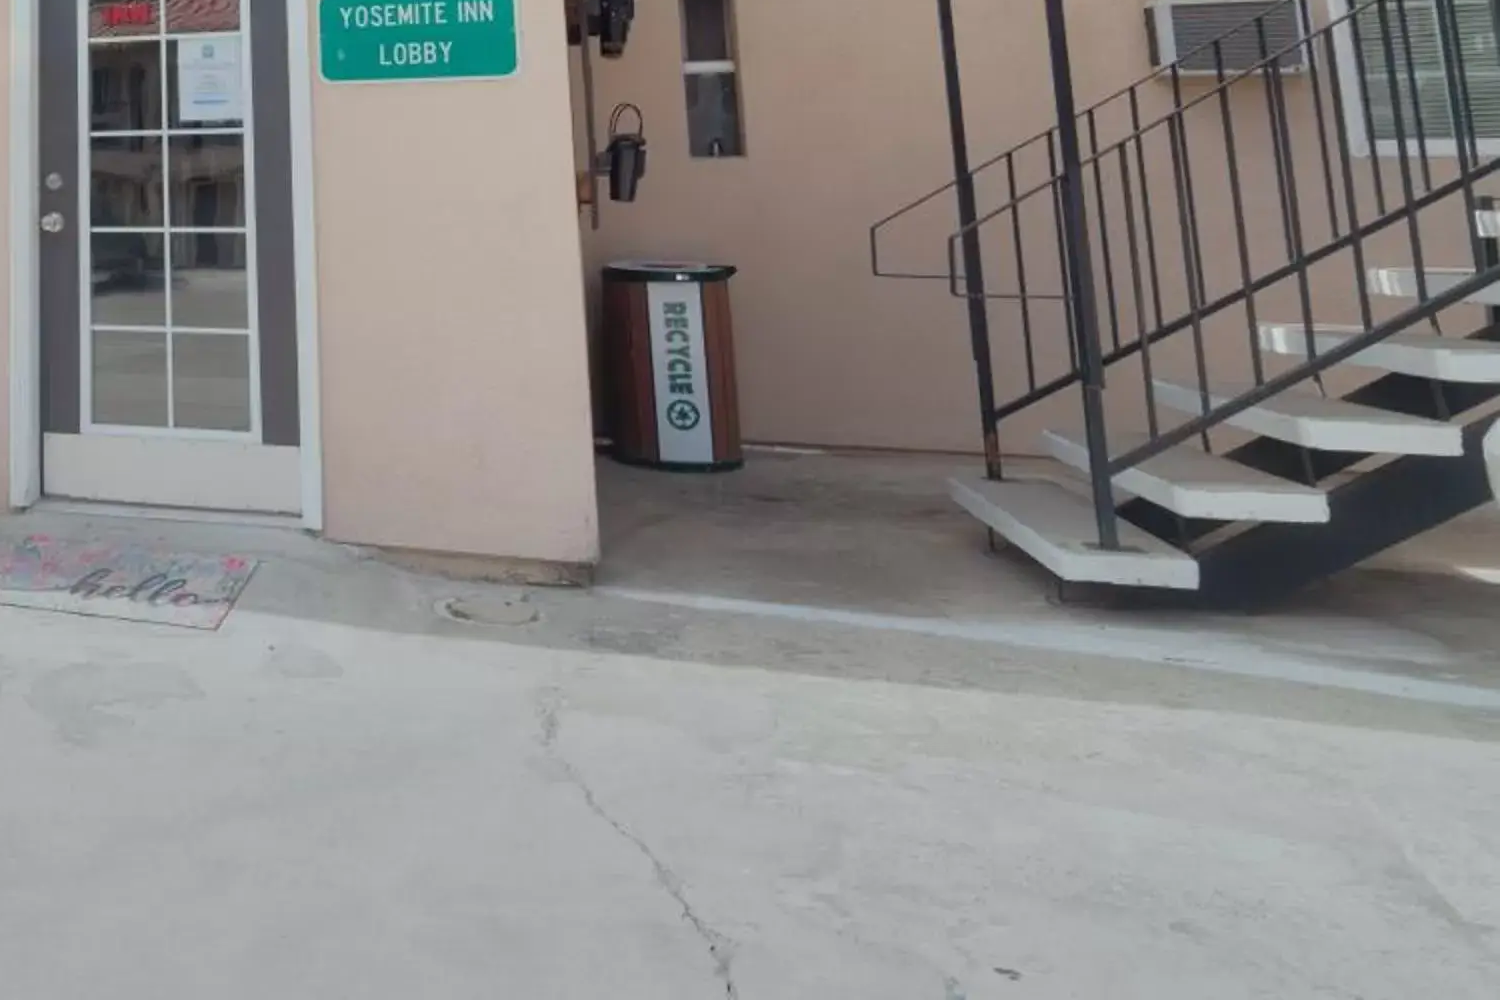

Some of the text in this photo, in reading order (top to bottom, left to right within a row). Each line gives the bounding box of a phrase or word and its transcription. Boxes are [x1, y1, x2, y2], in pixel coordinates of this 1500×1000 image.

[339, 0, 494, 29] YOSEMITE INN
[379, 41, 453, 66] LOBBY
[662, 301, 695, 396] RECYCLE
[69, 567, 230, 608] hello
